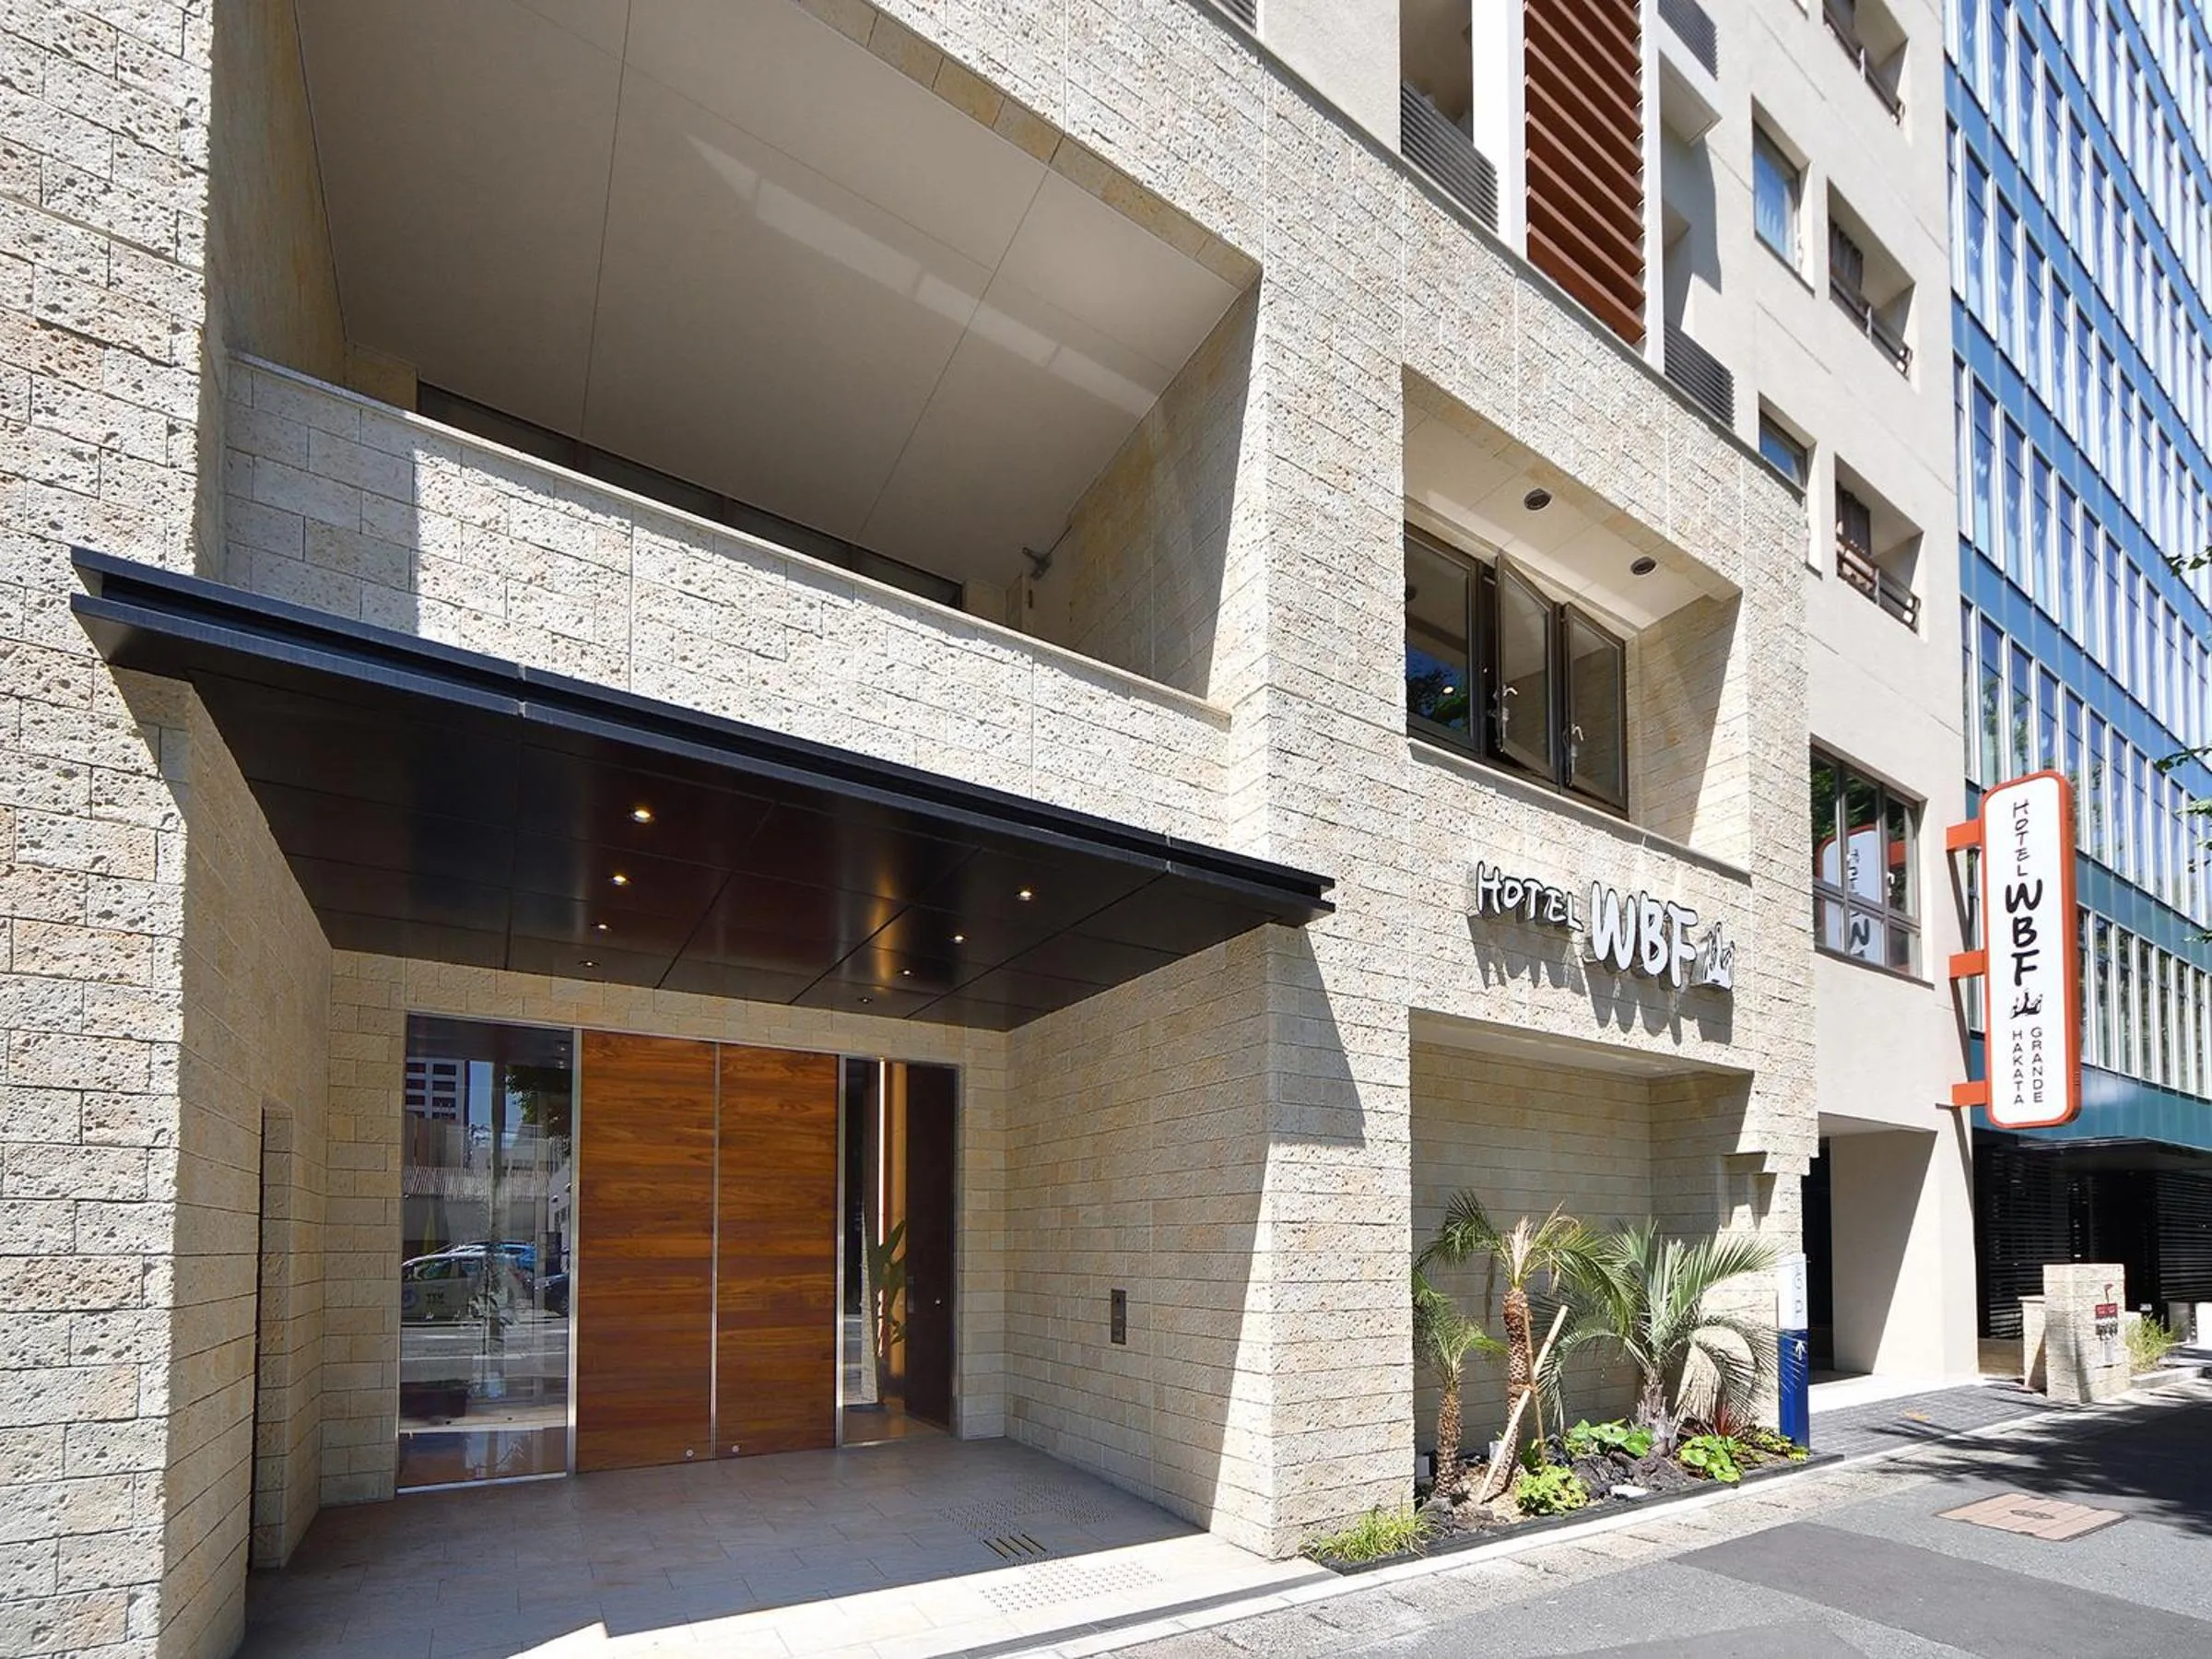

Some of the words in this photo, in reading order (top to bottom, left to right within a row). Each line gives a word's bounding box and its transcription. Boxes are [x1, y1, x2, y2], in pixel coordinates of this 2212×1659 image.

[2013, 799, 2030, 877] HOTEL
[1476, 860, 1584, 933] HOTEL
[1590, 880, 1699, 989] WBF
[2005, 878, 2043, 987] WBF
[2011, 1030, 2025, 1105] HAKATA
[2030, 1026, 2044, 1104] GRANDE
